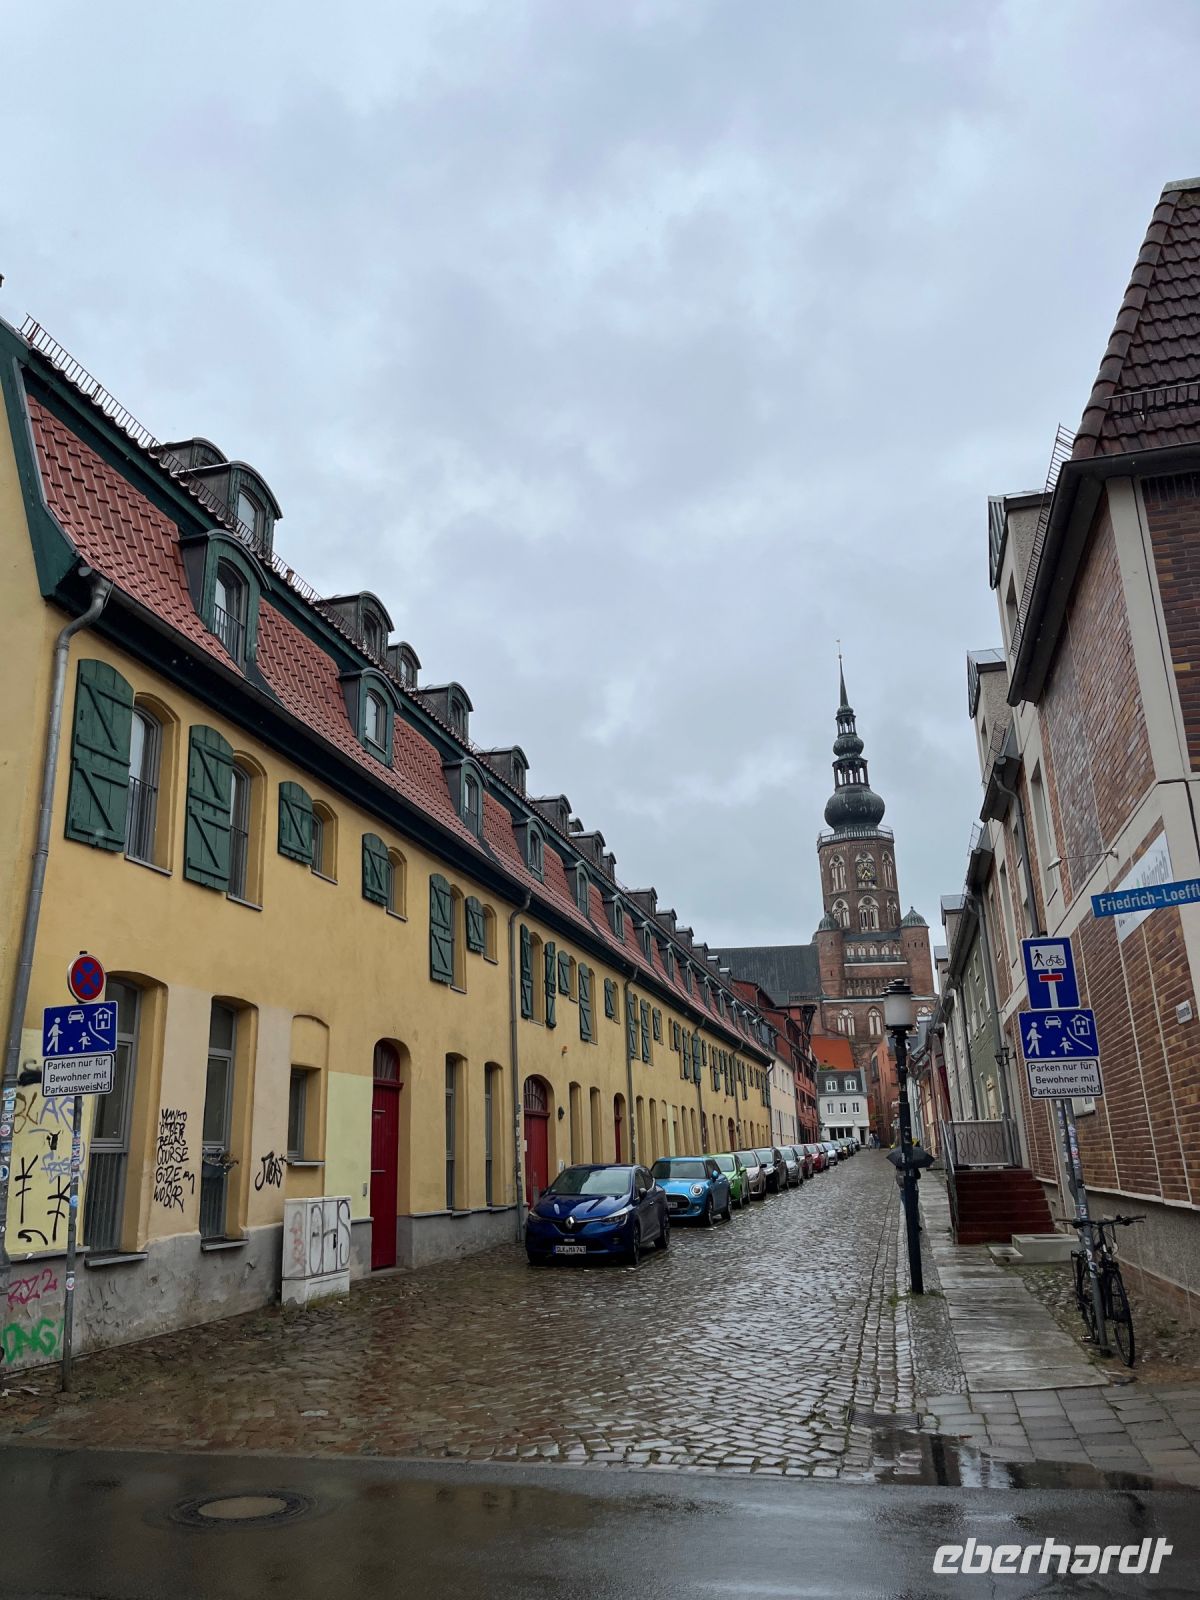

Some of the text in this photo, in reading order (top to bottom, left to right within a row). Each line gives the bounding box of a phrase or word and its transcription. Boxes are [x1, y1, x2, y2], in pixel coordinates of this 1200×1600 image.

[47, 1061, 76, 1070] Parken
[95, 1058, 108, 1066] für
[1030, 1064, 1060, 1072] Parken
[1080, 1062, 1093, 1070] für
[50, 1071, 107, 1083] Bewohner mit
[1035, 1074, 1095, 1084] Bewohner mit
